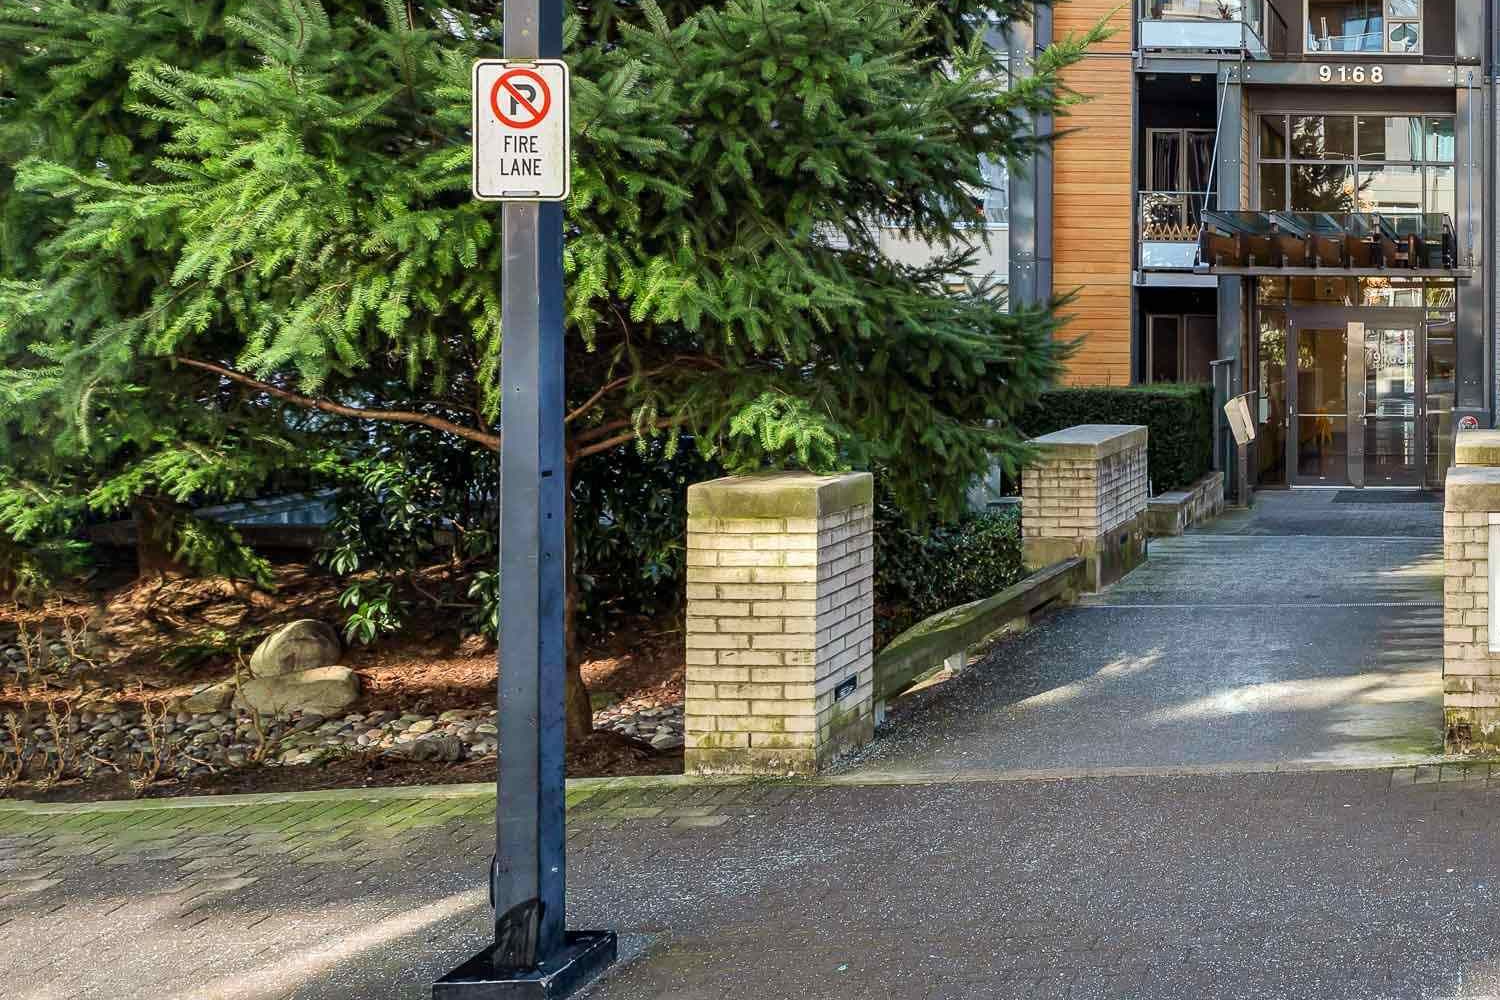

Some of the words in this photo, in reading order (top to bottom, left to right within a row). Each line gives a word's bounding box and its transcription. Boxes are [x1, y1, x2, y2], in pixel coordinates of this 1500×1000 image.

[1319, 65, 1383, 83] 9168
[504, 135, 538, 153] FIRE
[500, 158, 542, 176] LANE
